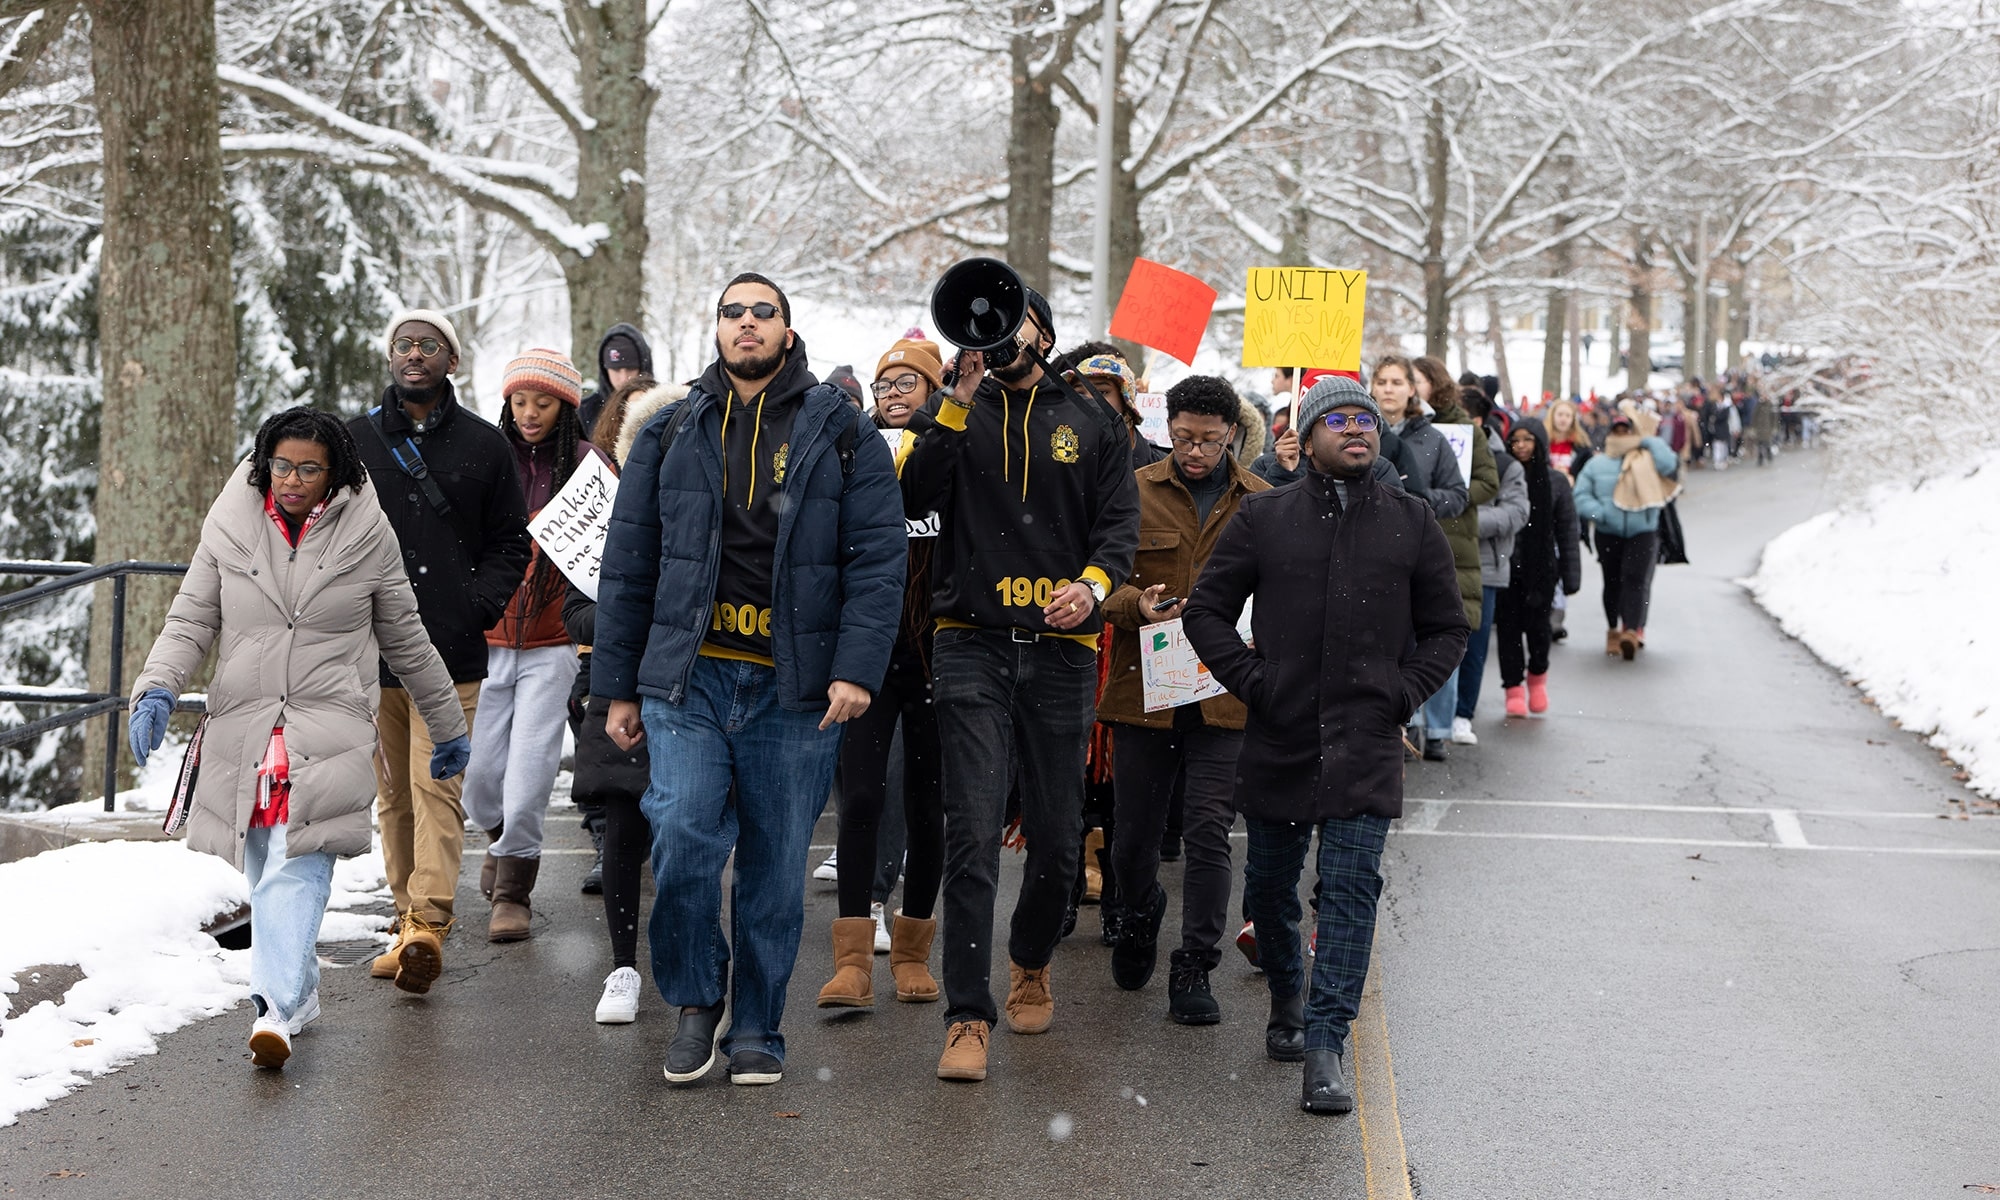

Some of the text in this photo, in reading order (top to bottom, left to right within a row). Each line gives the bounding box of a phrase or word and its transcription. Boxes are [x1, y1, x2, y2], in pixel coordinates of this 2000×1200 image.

[1254, 270, 1361, 304] UNITY
[1284, 305, 1315, 325] YES
[1261, 346, 1341, 361] WE CAN
[553, 487, 616, 553] CHANGE
[566, 544, 593, 571] one
